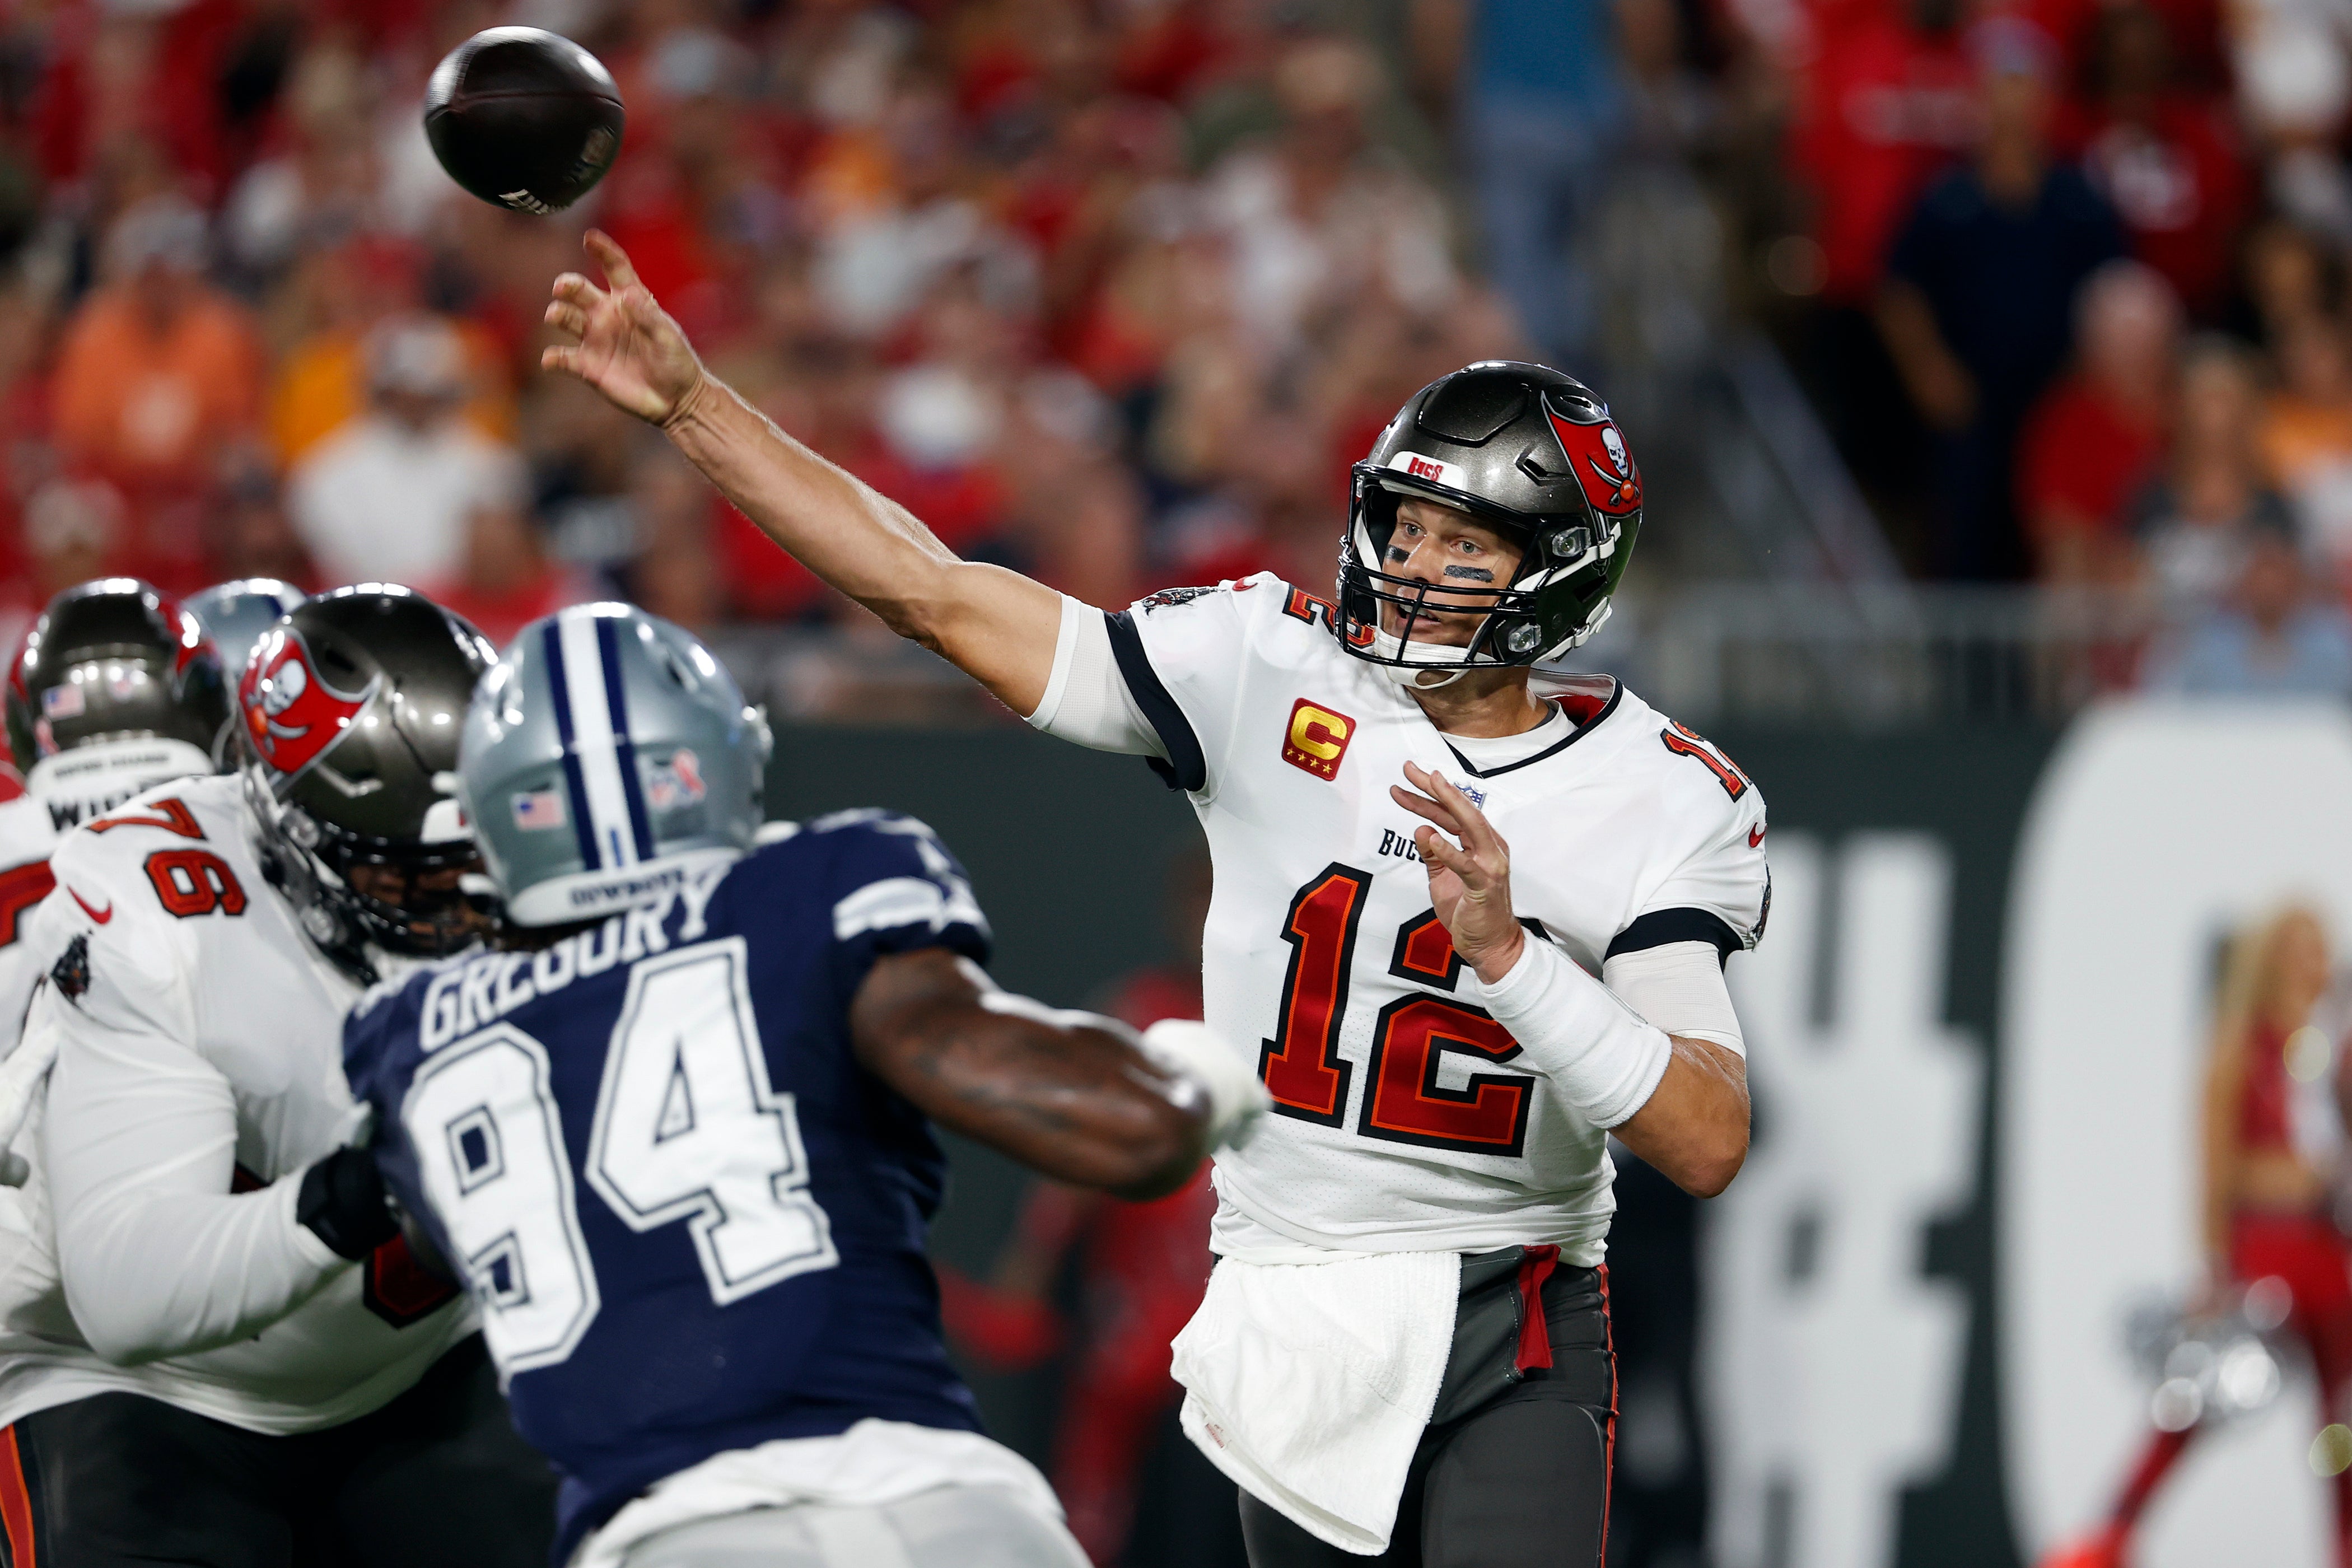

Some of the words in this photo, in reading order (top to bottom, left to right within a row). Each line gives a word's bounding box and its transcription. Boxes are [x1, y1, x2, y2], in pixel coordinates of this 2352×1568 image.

[1291, 706, 1347, 760] C
[1378, 828, 1426, 864] BUC
[1258, 862, 1551, 1158] 12
[400, 934, 840, 1397] 94
